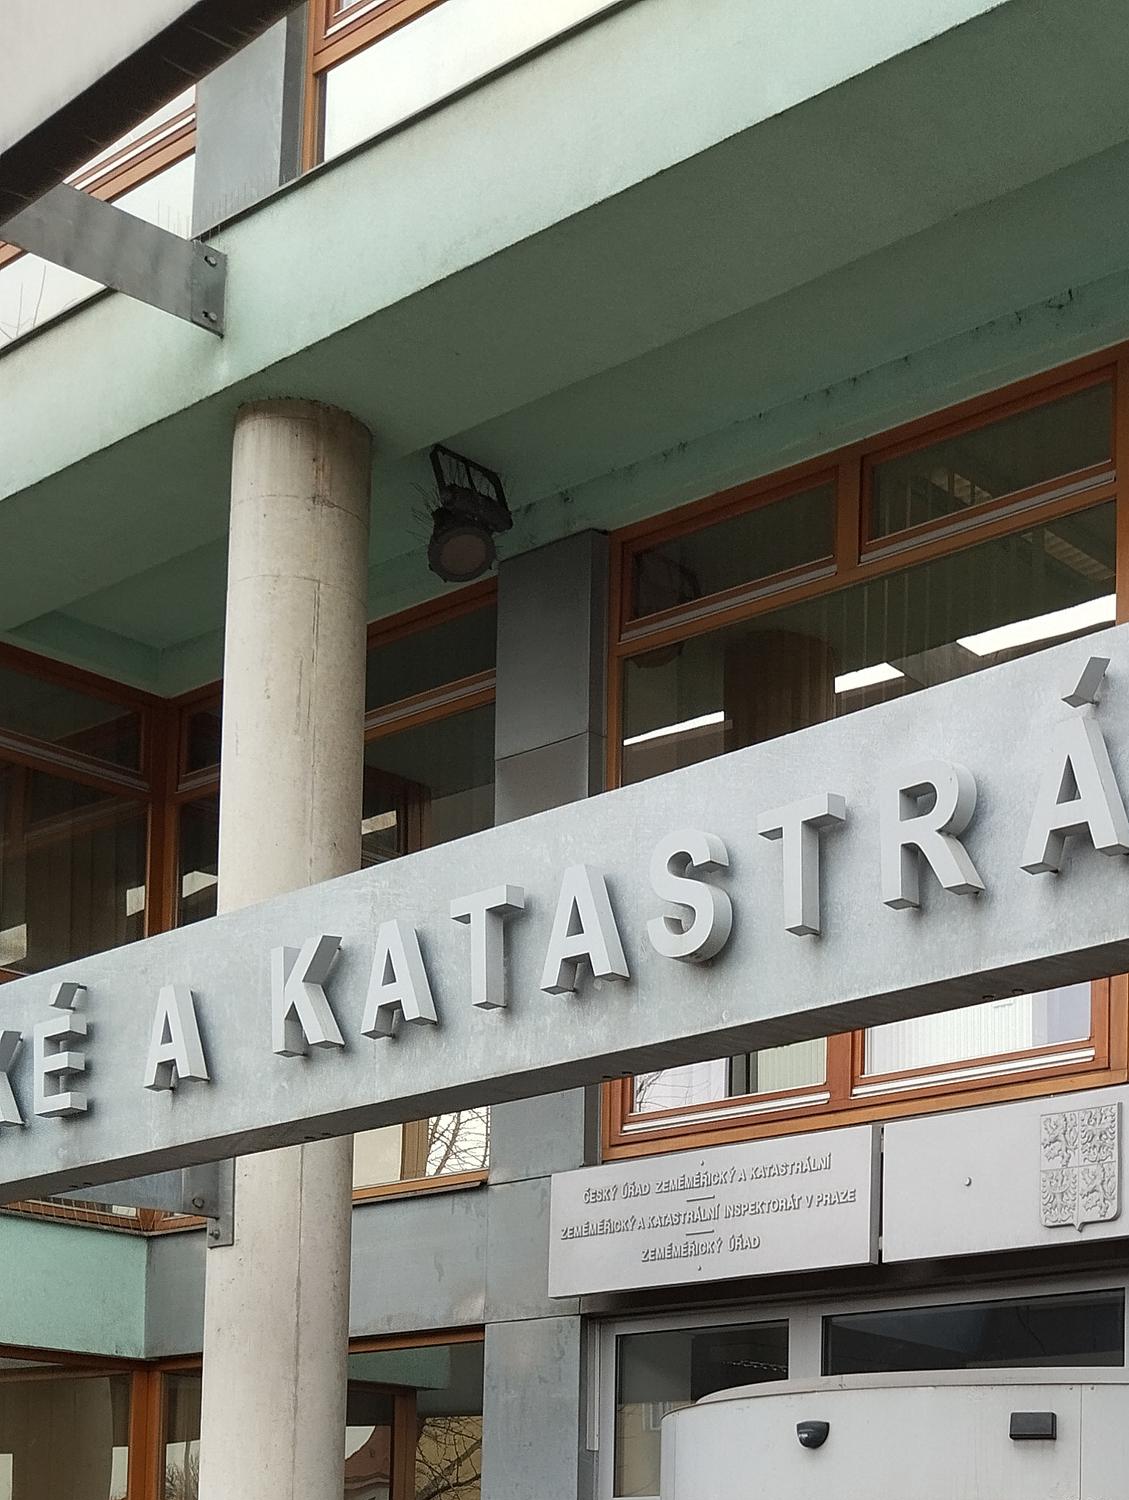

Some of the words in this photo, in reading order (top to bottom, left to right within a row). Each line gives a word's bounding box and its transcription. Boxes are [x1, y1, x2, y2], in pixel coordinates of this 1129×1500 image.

[144, 983, 210, 1092] A
[583, 1184, 618, 1204] ČESKÝ
[622, 1181, 650, 1200] ÚŘAD
[655, 1165, 736, 1194] ZEMĚMĚŘICKÝ
[738, 1169, 747, 1183] A
[750, 1152, 832, 1180] KATASTRÁLNÍ
[561, 1215, 637, 1240] ZEMĚMĚŘICKÝ
[637, 1217, 646, 1230] A
[648, 1203, 720, 1229] KATASTRÁLNÍ
[724, 1193, 802, 1219] INSPEKTORÁT
[805, 1195, 814, 1208] V
[816, 1189, 857, 1208] PRAZE
[641, 1237, 723, 1262] ZEMĚMĚŘICKÝ
[728, 1233, 760, 1252] ÚŘAD
